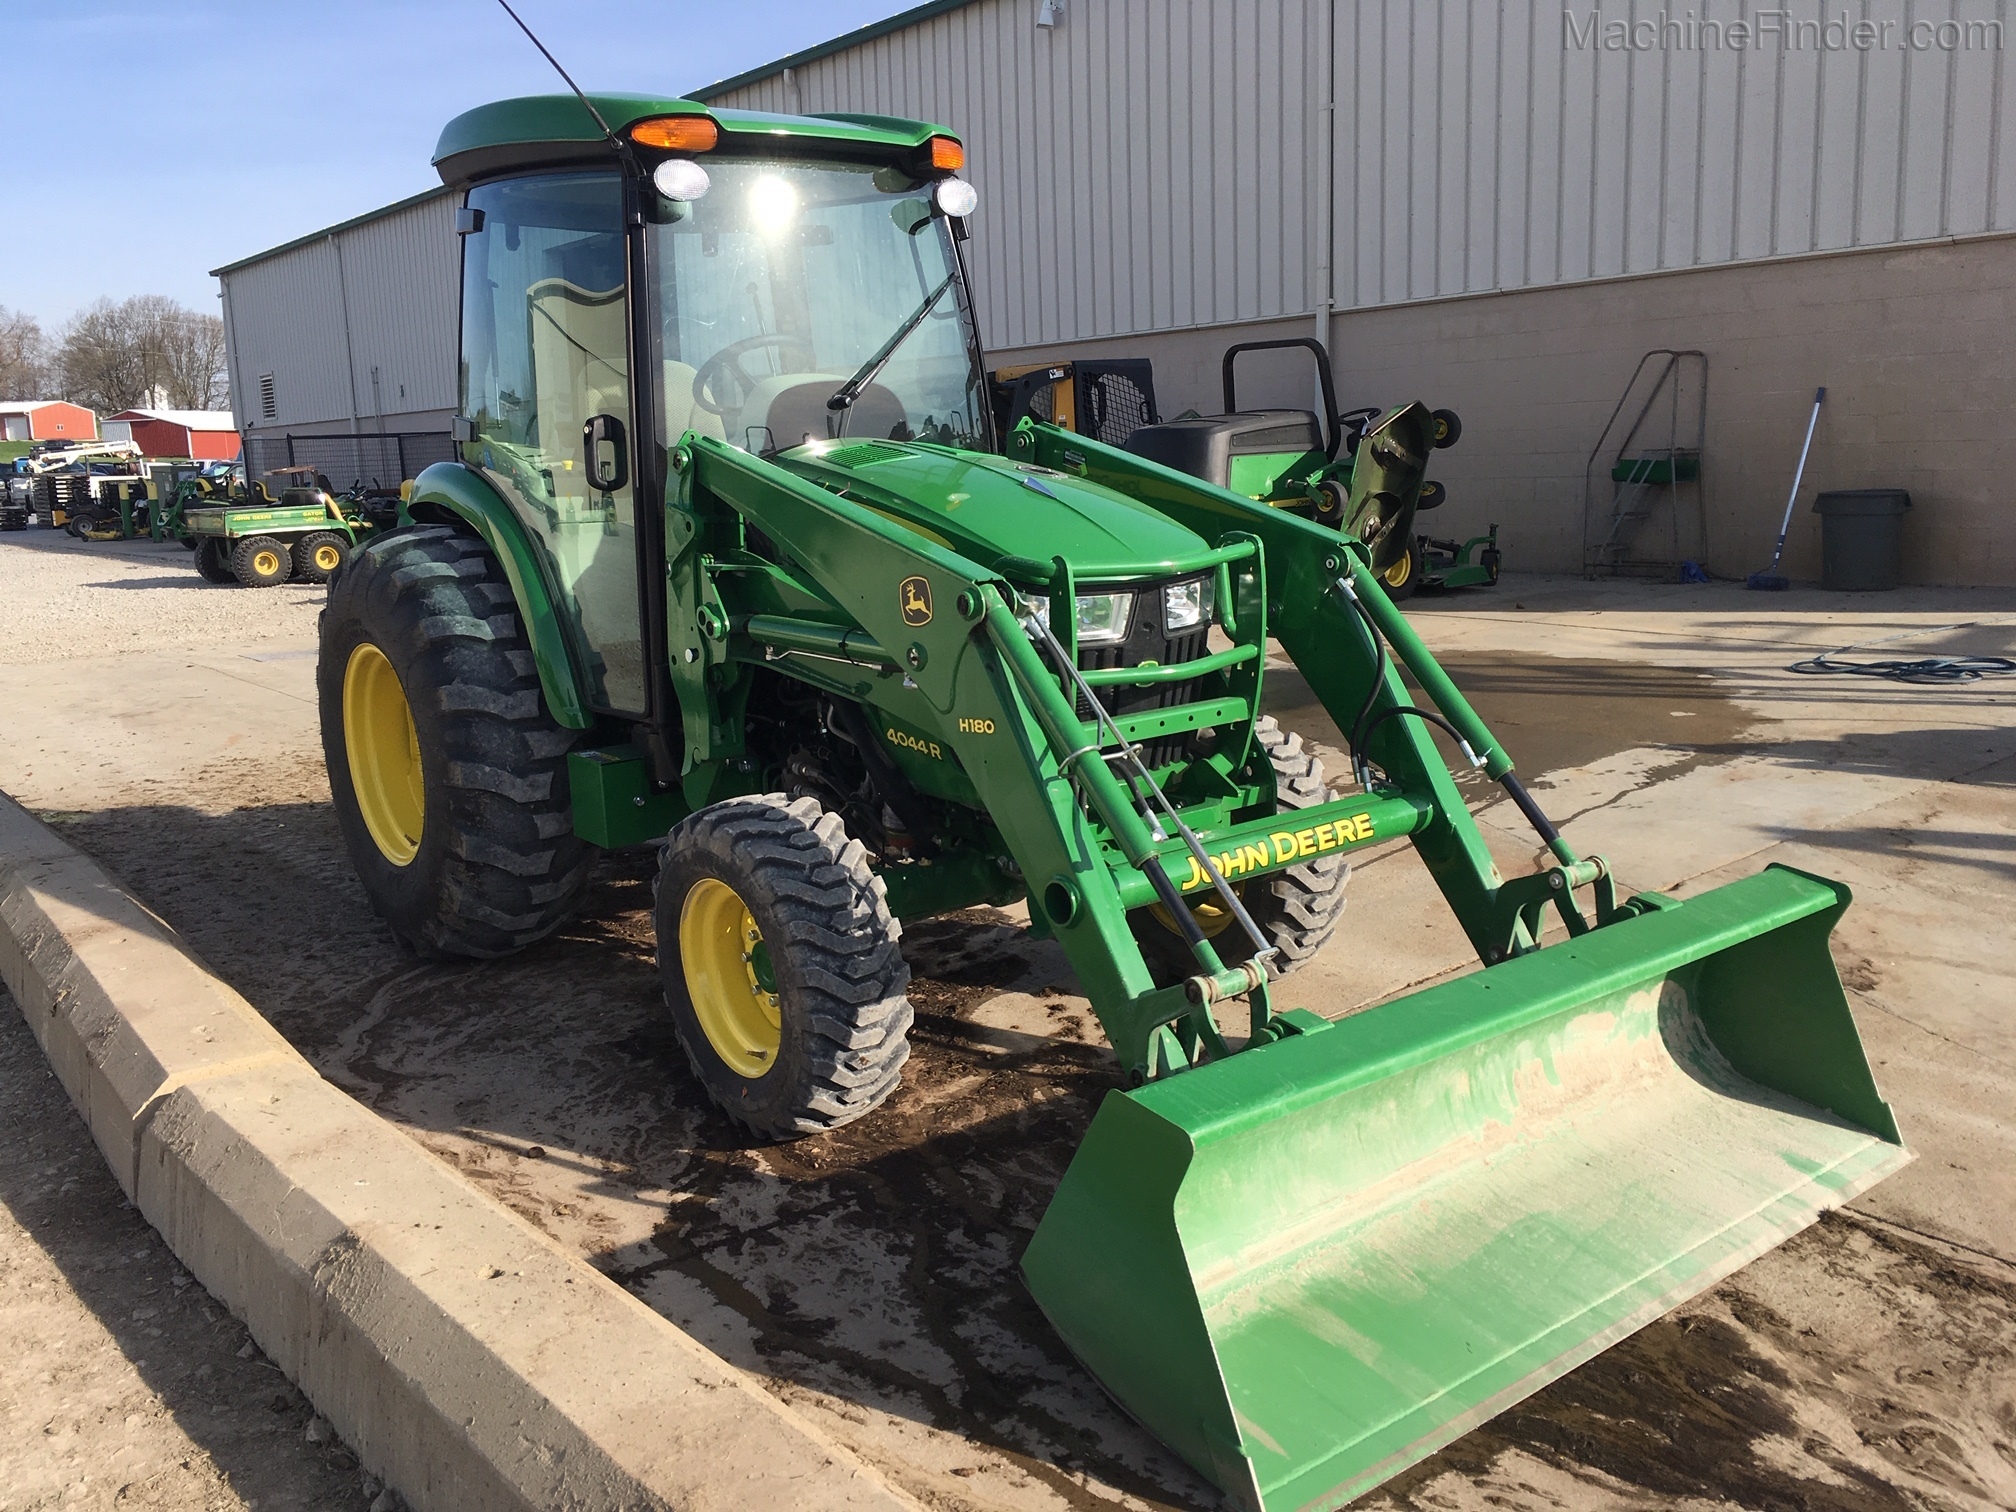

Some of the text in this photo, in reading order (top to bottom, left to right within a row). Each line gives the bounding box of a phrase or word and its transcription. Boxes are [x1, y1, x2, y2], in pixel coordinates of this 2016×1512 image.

[958, 717, 996, 735] H180
[886, 727, 943, 761] 4044R
[1181, 812, 1375, 891] JOHN DEERE
